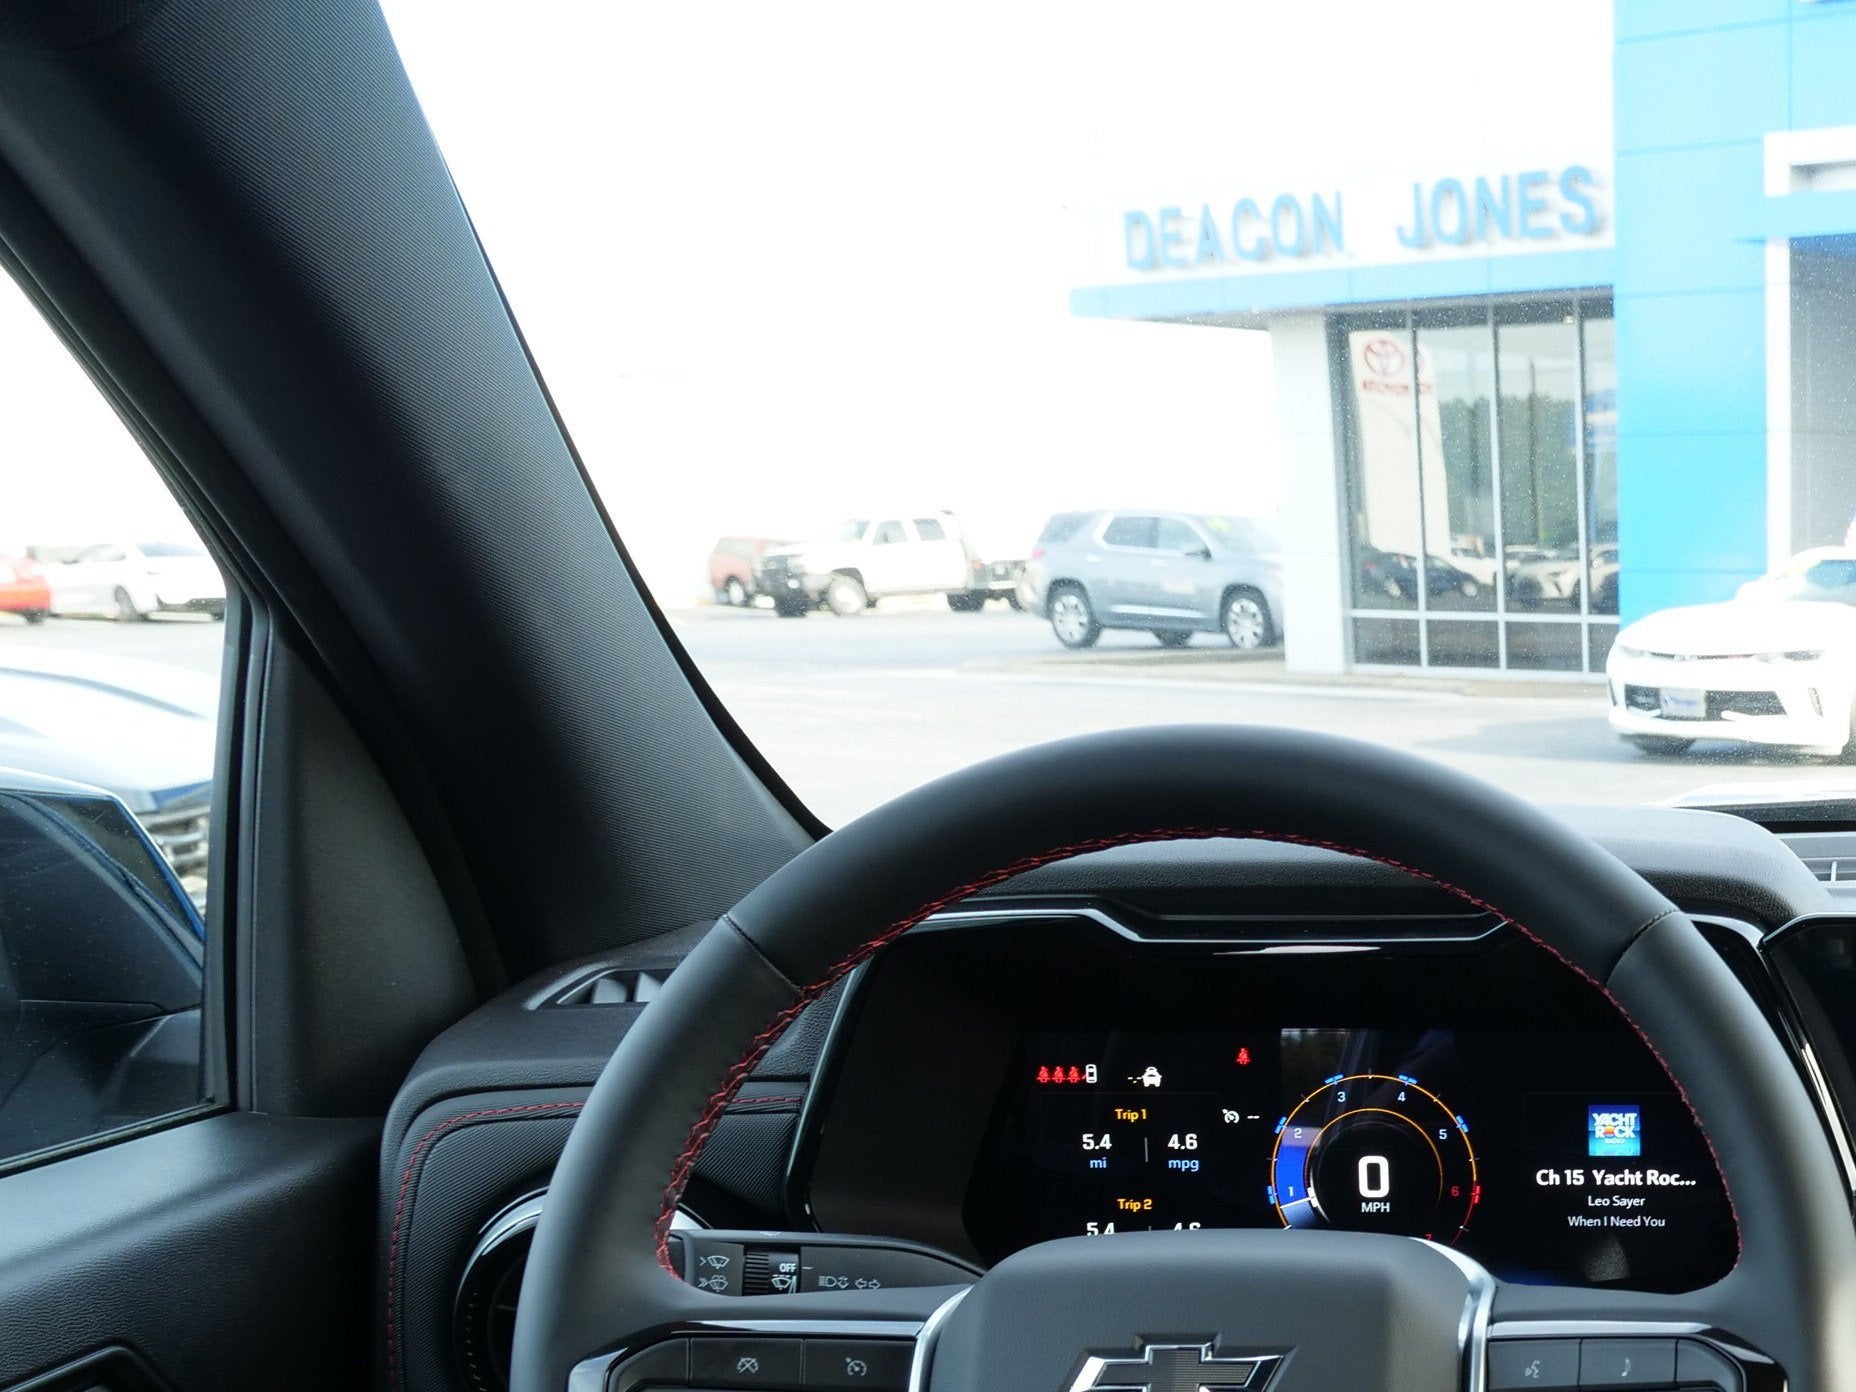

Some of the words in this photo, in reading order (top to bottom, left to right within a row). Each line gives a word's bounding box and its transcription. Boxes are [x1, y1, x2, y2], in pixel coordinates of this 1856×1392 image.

[1122, 190, 1345, 271] DEACON
[1396, 165, 1602, 249] JONES
[1337, 1092, 1346, 1102] 3
[1397, 1092, 1406, 1102] 4
[1115, 1109, 1140, 1122] Trip
[1141, 1109, 1147, 1120] 1
[1592, 1113, 1637, 1126] YACHT
[1293, 1128, 1302, 1139] 2
[1438, 1129, 1448, 1140] 5
[1595, 1125, 1636, 1139] ROCK
[1082, 1134, 1112, 1150] 5.4
[1167, 1134, 1198, 1150] 4.6
[1090, 1157, 1107, 1168] mi
[1168, 1159, 1200, 1172] mpg
[1358, 1156, 1390, 1198] 0
[1536, 1169, 1560, 1186] Ch
[1564, 1169, 1584, 1186] 15
[1592, 1169, 1643, 1186] Yacht
[1646, 1169, 1697, 1186] Roc...
[1288, 1186, 1294, 1197] 1
[1451, 1186, 1460, 1197] 6
[1117, 1199, 1141, 1212] Trip
[1143, 1199, 1152, 1210] 2
[1361, 1202, 1390, 1213] MPH
[1588, 1196, 1610, 1206] Leo
[1612, 1196, 1645, 1209] Sayer
[1567, 1216, 1600, 1227] When
[1610, 1216, 1641, 1227] Need
[1642, 1216, 1666, 1227] You
[1086, 1223, 1115, 1236] 54
[778, 1263, 798, 1273] OFF
